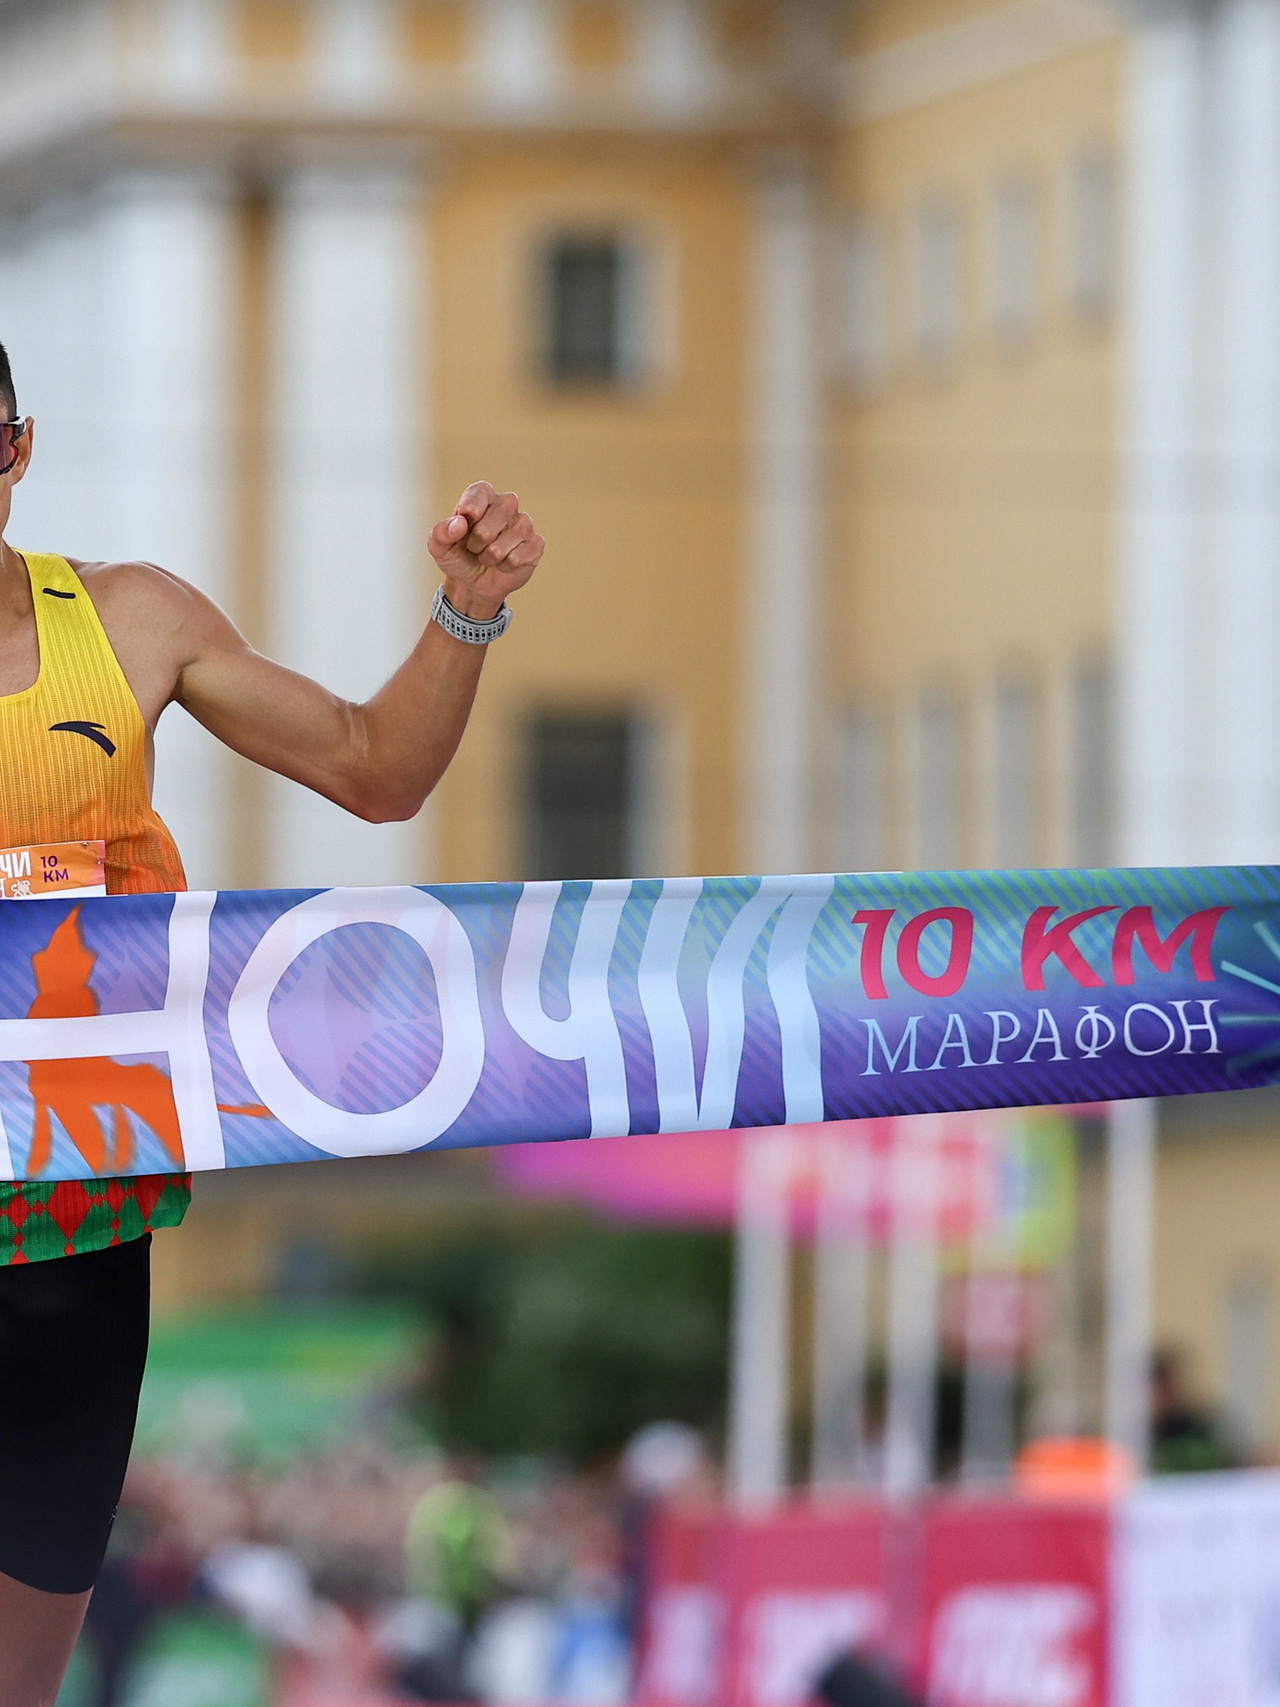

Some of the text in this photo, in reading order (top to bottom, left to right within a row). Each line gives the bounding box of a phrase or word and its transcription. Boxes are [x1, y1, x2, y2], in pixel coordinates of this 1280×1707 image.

[40, 855, 58, 869] 10
[43, 868, 69, 883] КМ
[851, 905, 1233, 1000] 10 КМ
[858, 999, 1222, 1076] МАРАФОН
